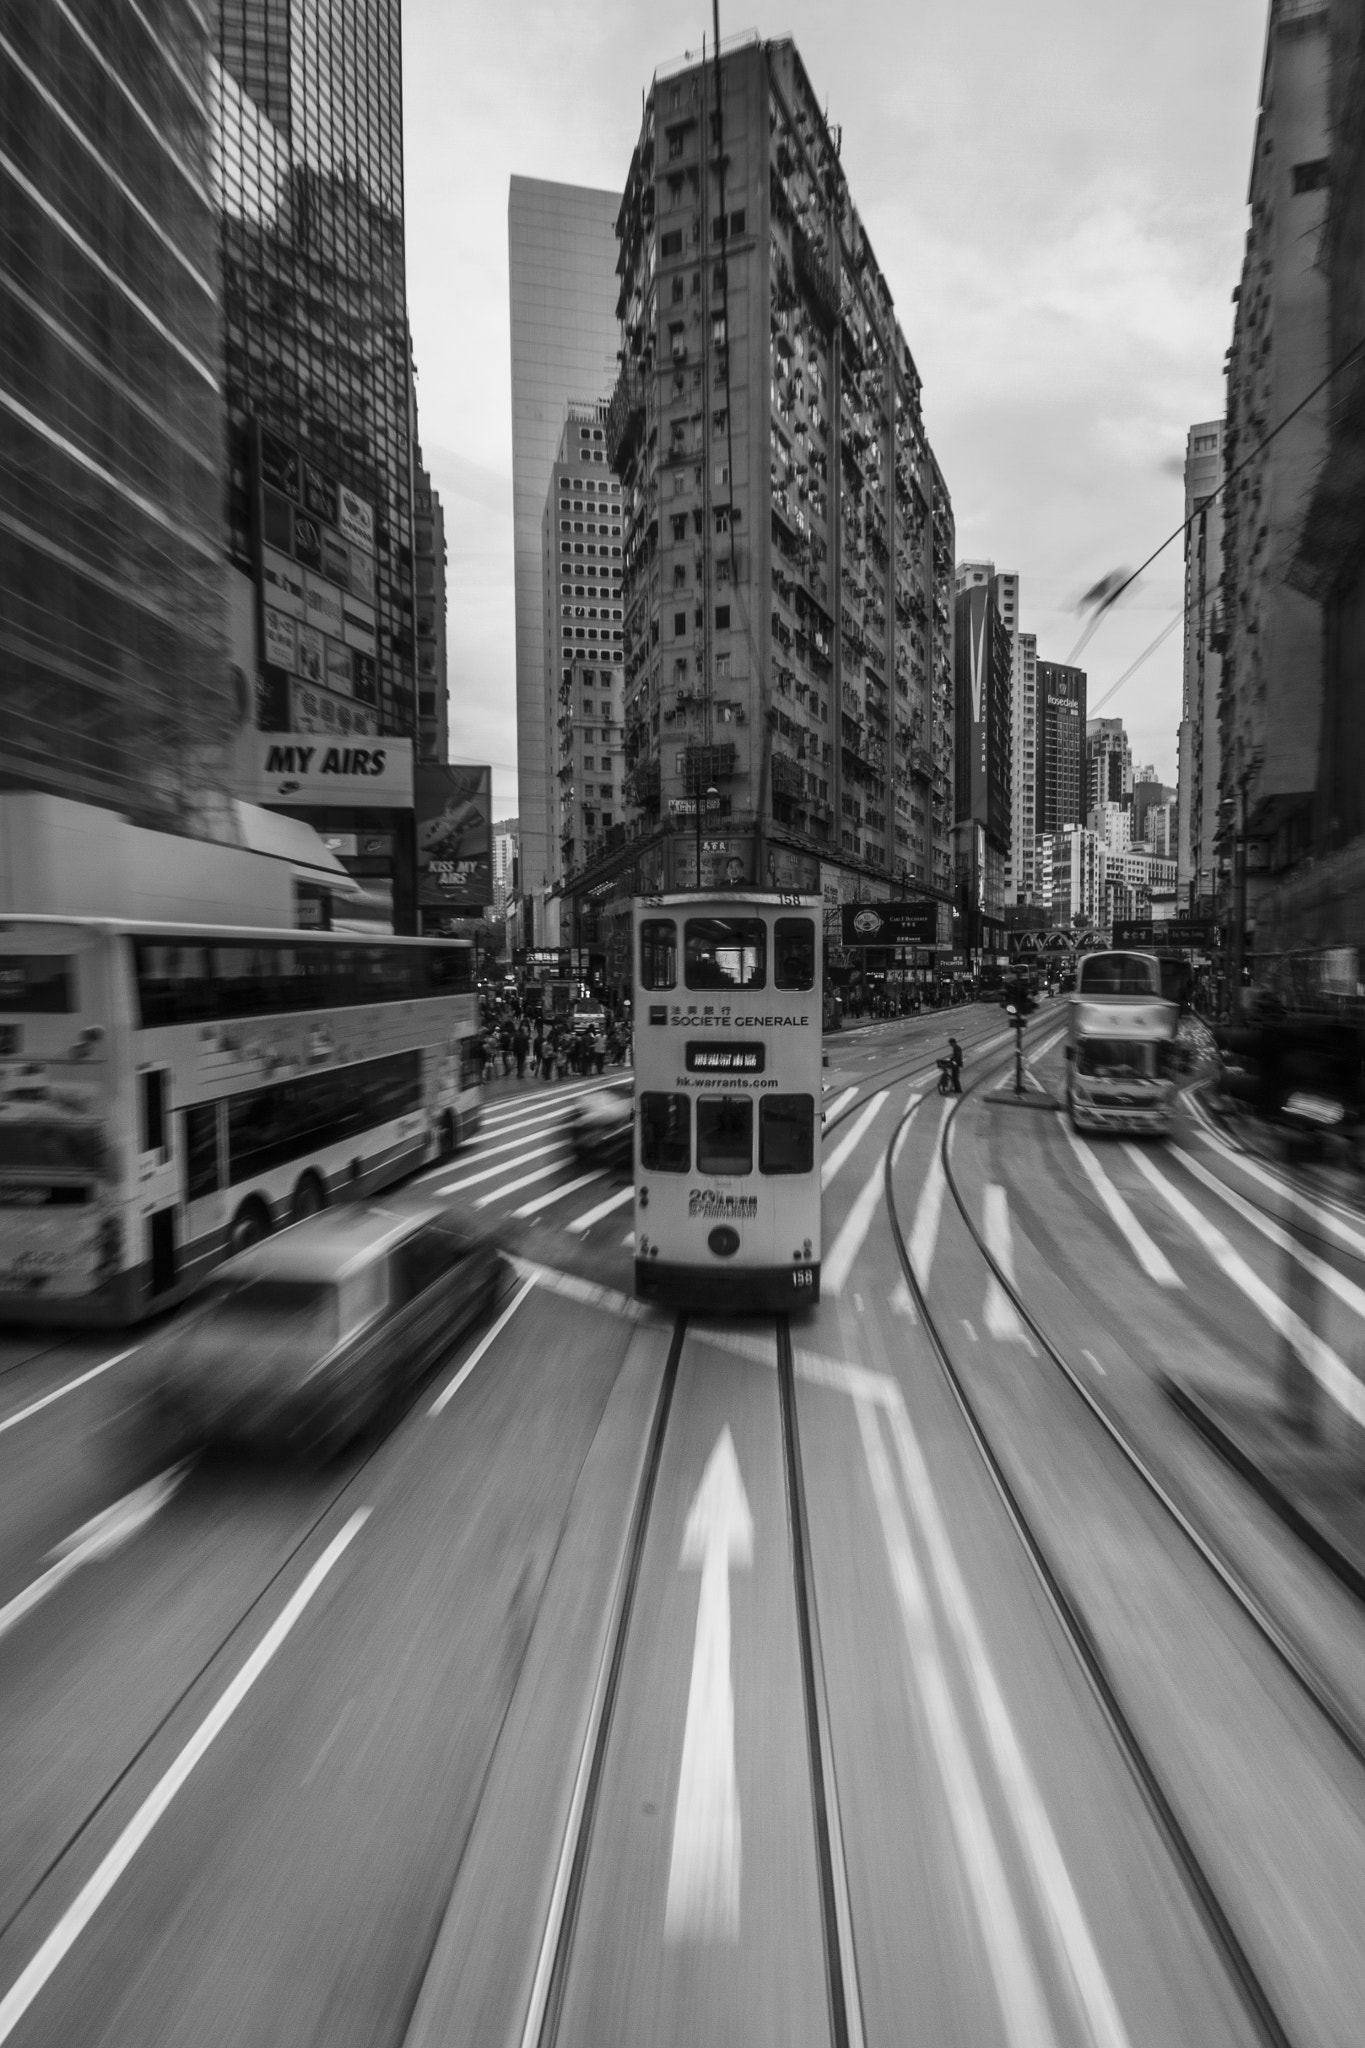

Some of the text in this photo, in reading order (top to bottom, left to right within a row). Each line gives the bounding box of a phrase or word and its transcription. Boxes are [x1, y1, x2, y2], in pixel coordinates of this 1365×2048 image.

[1047, 694, 1079, 709] Rosedale
[265, 745, 387, 775] MY AIRS
[428, 861, 478, 873] KISS MY
[438, 872, 467, 885] AIRS
[779, 894, 801, 906] 158
[671, 1006, 731, 1016] 法興銀行
[671, 1016, 809, 1026] SOCIETE GENERALE
[675, 1076, 779, 1088] hk.warrants.com
[792, 1269, 813, 1288] 158
